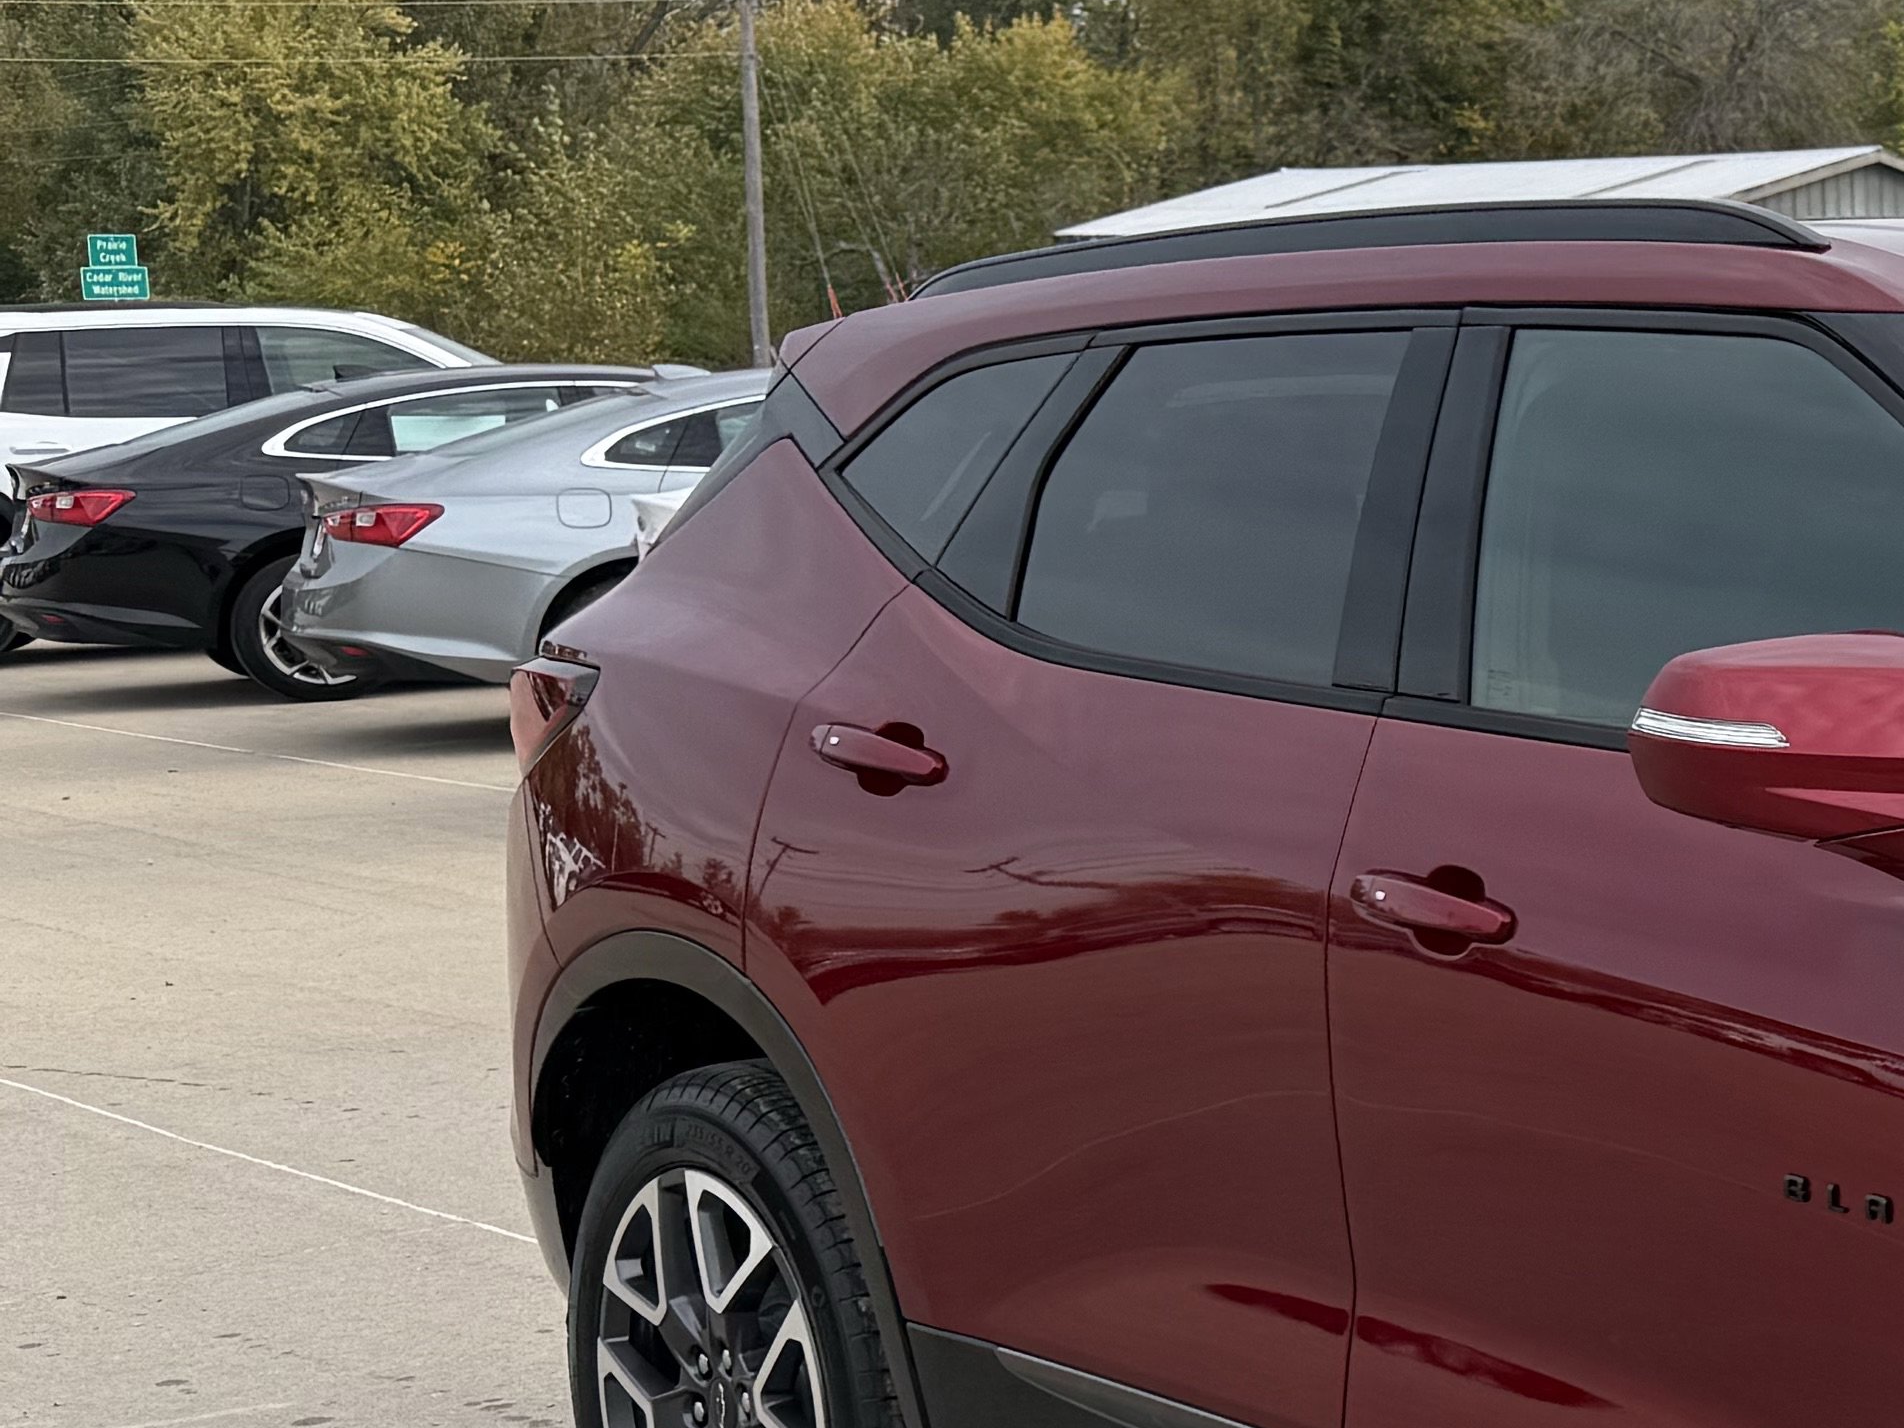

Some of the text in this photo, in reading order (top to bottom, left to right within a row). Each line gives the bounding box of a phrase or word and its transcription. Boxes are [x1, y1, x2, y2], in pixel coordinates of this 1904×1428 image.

[99, 252, 127, 263] Creek
[86, 272, 142, 282] Cedar River
[92, 284, 140, 295] Watershed
